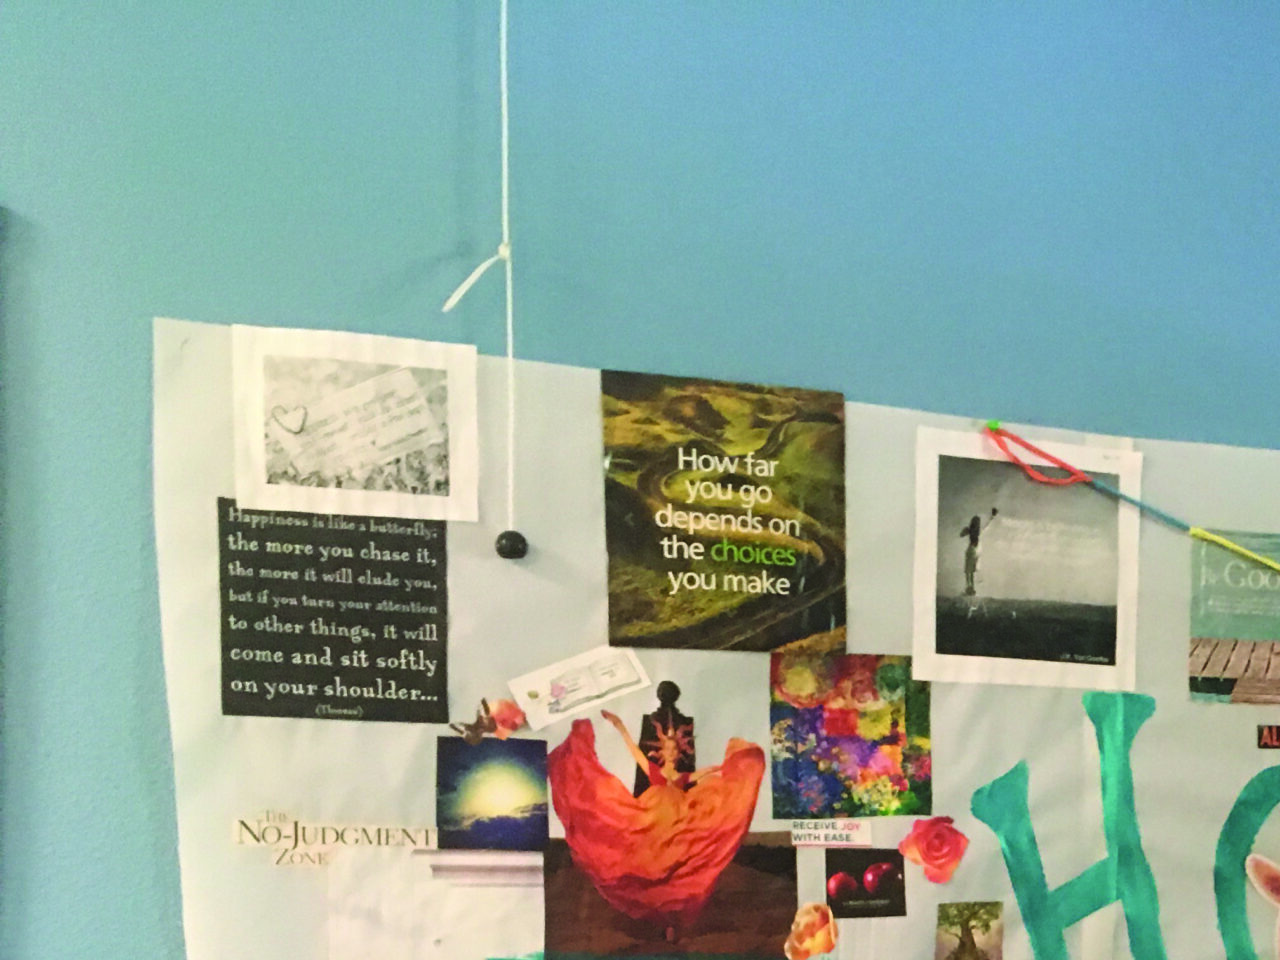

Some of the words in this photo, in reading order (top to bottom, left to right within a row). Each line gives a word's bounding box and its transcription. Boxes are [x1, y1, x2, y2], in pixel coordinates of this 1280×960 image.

[677, 447, 738, 474] How
[746, 451, 779, 478] far
[684, 479, 732, 505] you
[739, 483, 773, 508] go
[229, 507, 308, 528] Happiness
[313, 516, 324, 528] is
[329, 514, 354, 530] like
[359, 523, 365, 531] a
[655, 504, 763, 534] depends
[769, 517, 800, 537] on
[227, 532, 259, 551] the
[266, 542, 313, 555] more
[319, 545, 353, 561] you
[360, 542, 410, 562] chase
[416, 548, 437, 567] it,
[660, 535, 705, 559] the
[710, 538, 797, 566] choices
[228, 561, 254, 577] the
[259, 567, 298, 581] more
[304, 568, 317, 582] it
[322, 568, 353, 584] will
[358, 572, 400, 587] elude
[404, 578, 437, 592] you,
[667, 569, 716, 595] you
[723, 570, 791, 596] make
[229, 589, 254, 602] but
[257, 589, 269, 604] if
[272, 595, 297, 609] you
[302, 595, 334, 609] turn
[339, 600, 372, 612] your
[375, 600, 437, 615] attention
[228, 615, 247, 630] to
[254, 615, 304, 634] other
[309, 618, 376, 644] things,
[383, 624, 397, 640] it
[404, 624, 438, 642] will
[230, 647, 284, 663] come
[290, 647, 333, 667] and
[340, 650, 369, 668] sit
[376, 650, 438, 677] softly
[230, 679, 258, 693] on
[264, 682, 318, 700] your
[324, 677, 438, 701] shoulder...
[792, 821, 837, 830] RECEIVE
[841, 823, 861, 831] JOY
[793, 833, 820, 841] WITH
